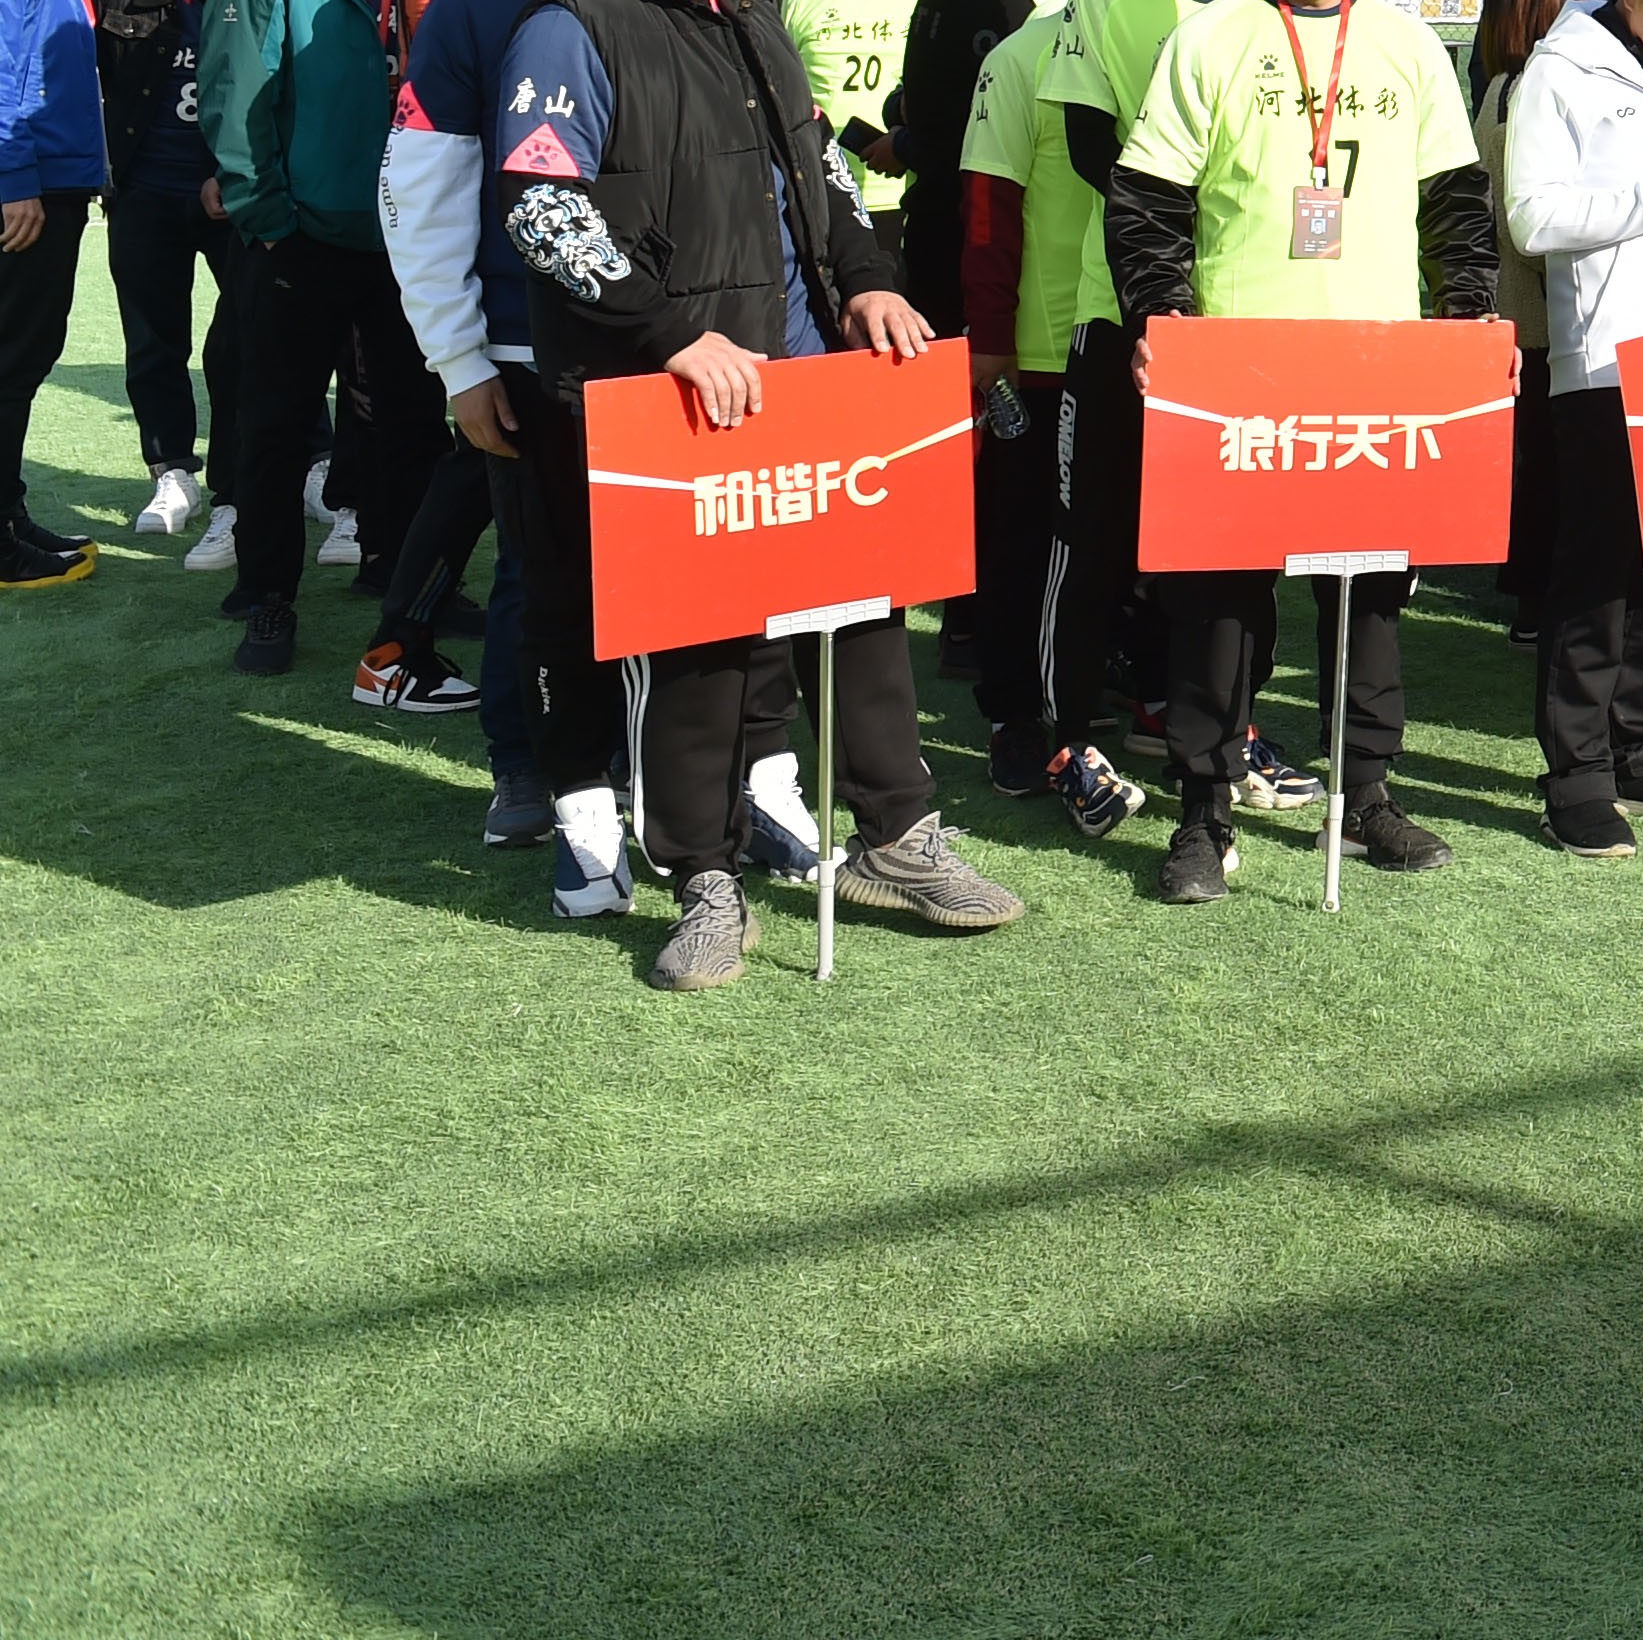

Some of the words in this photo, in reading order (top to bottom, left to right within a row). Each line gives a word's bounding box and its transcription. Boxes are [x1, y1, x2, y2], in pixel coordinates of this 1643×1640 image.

[815, 22, 909, 42] 河北体
[842, 55, 882, 92] 20
[508, 77, 576, 119] 唐山
[1255, 85, 1399, 120] 河北体彩
[1219, 415, 1446, 471] 狼行天下
[694, 455, 889, 536] 和谐FC
